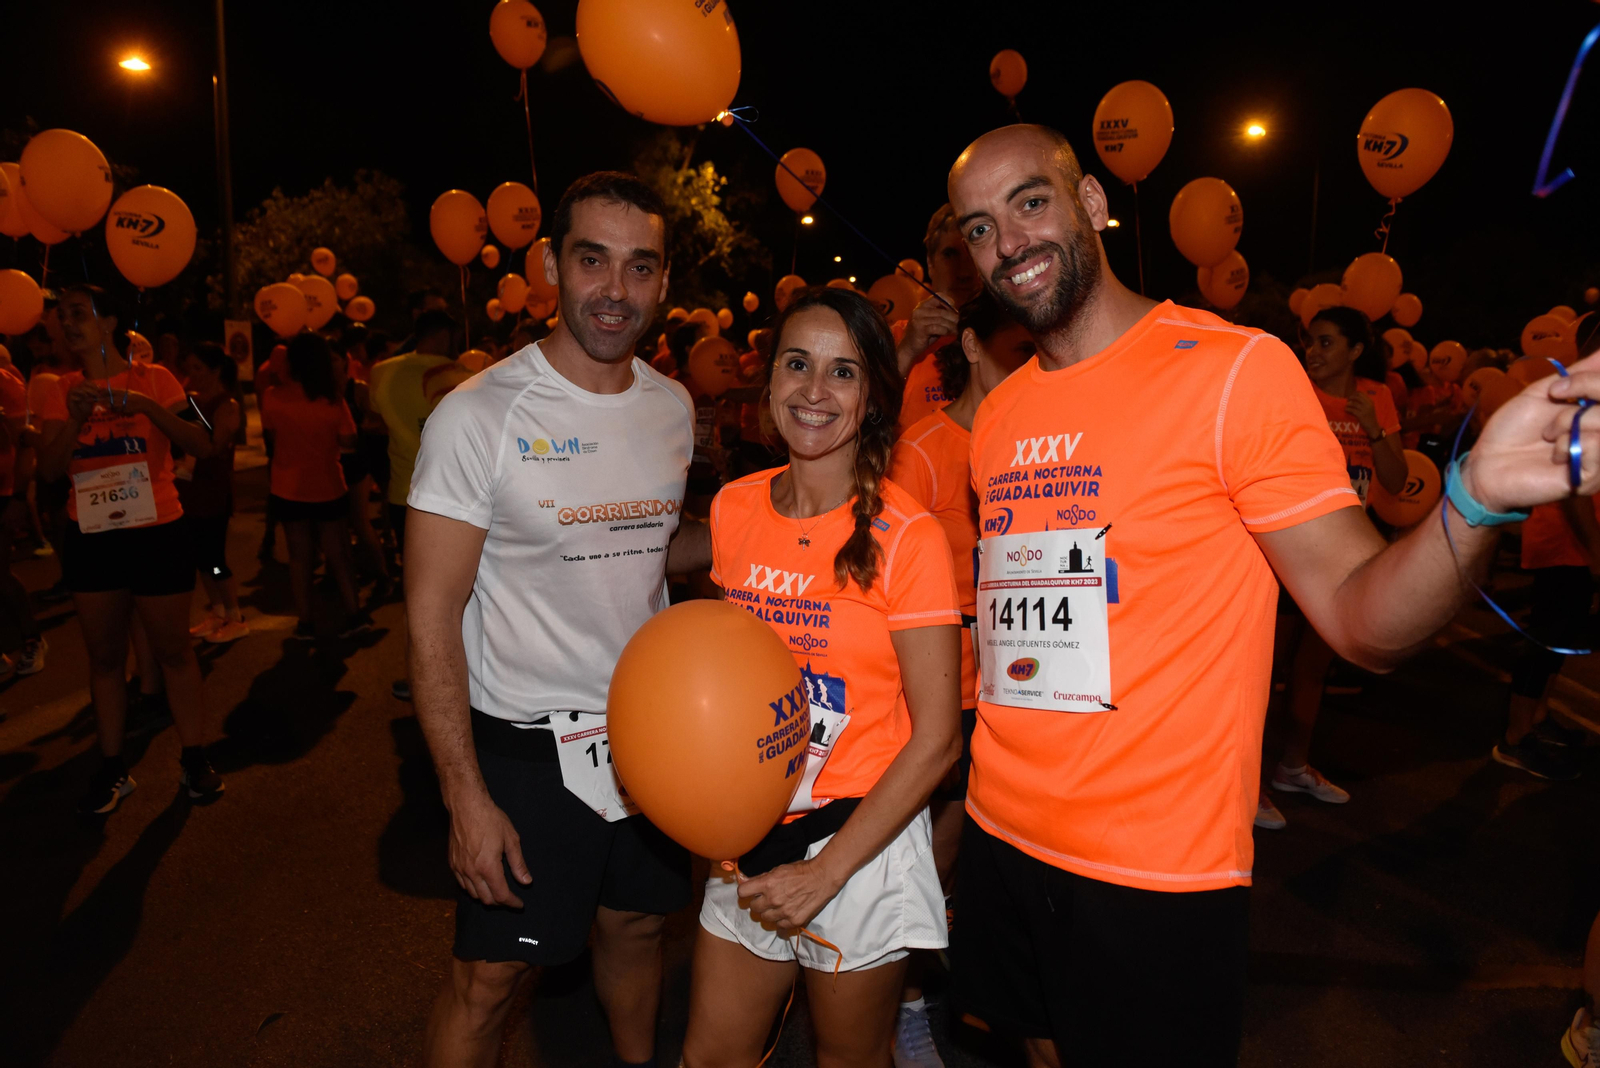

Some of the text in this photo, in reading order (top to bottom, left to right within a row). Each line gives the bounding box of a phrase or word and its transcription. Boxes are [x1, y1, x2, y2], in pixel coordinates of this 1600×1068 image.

[1010, 432, 1084, 468] XXXV
[987, 465, 1103, 487] CARRERA NOCTURNA
[90, 486, 139, 506] 21636
[989, 481, 1100, 503] GUADALQUIVIR
[538, 500, 555, 508] VII
[636, 520, 664, 530] solidaria
[743, 563, 815, 597] XXXV
[1031, 579, 1070, 587] GUADALQUIVIR
[724, 587, 832, 612] ARRERA NOCTURNA
[990, 597, 1072, 631] 14114
[1016, 640, 1050, 648] CIFUENTES
[1052, 639, 1080, 649] GÓMEZ
[1053, 691, 1101, 703] Cruzcampo
[577, 729, 598, 738] CARRERA
[757, 718, 799, 748] CARRERA
[785, 747, 807, 779] KH
